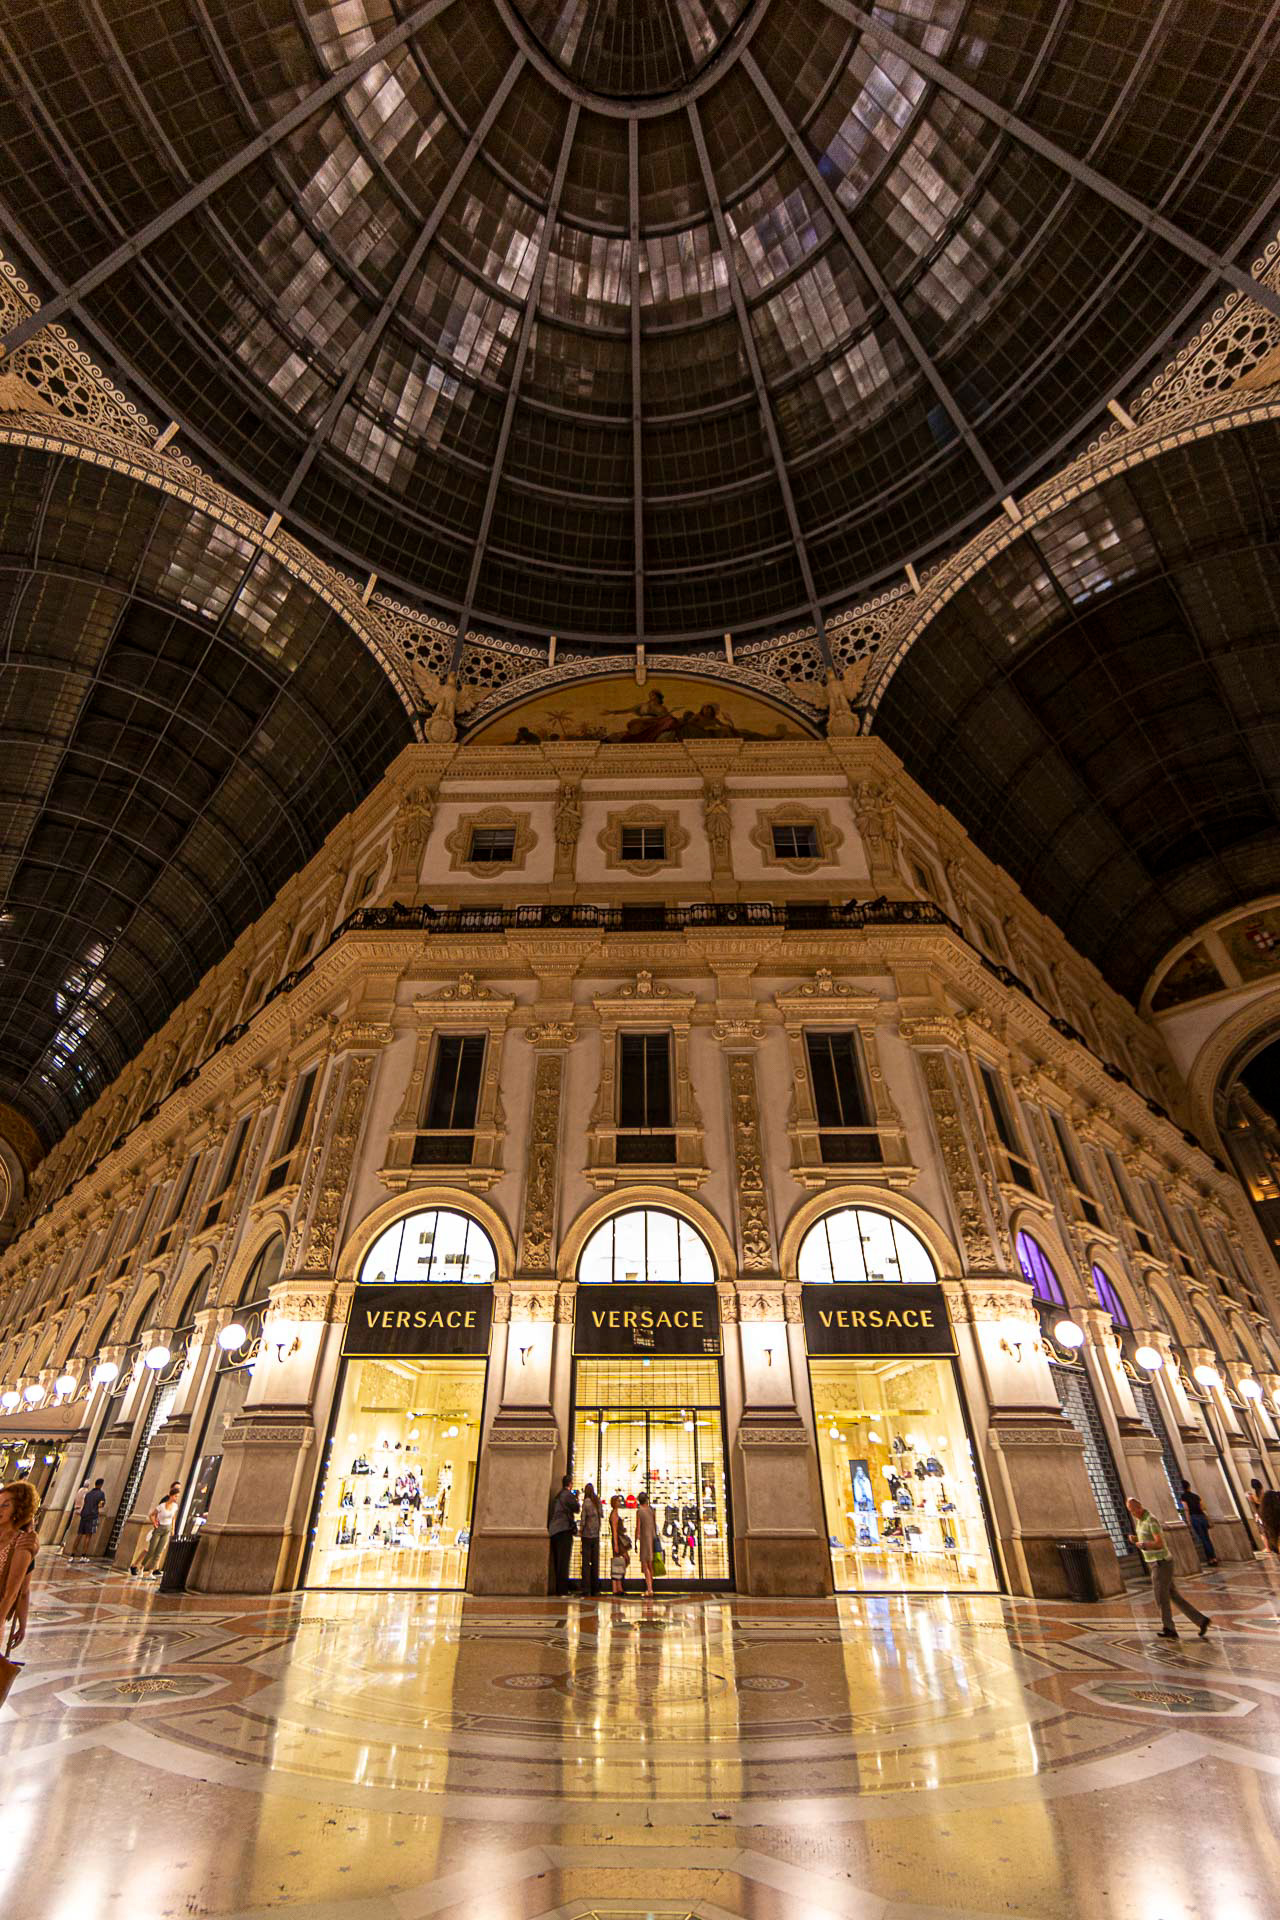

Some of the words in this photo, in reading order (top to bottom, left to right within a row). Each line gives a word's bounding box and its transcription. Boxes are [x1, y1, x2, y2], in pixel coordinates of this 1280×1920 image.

[365, 1310, 477, 1328] VERSACE
[591, 1310, 704, 1328] VERSACE
[818, 1310, 935, 1328] VERSACE
